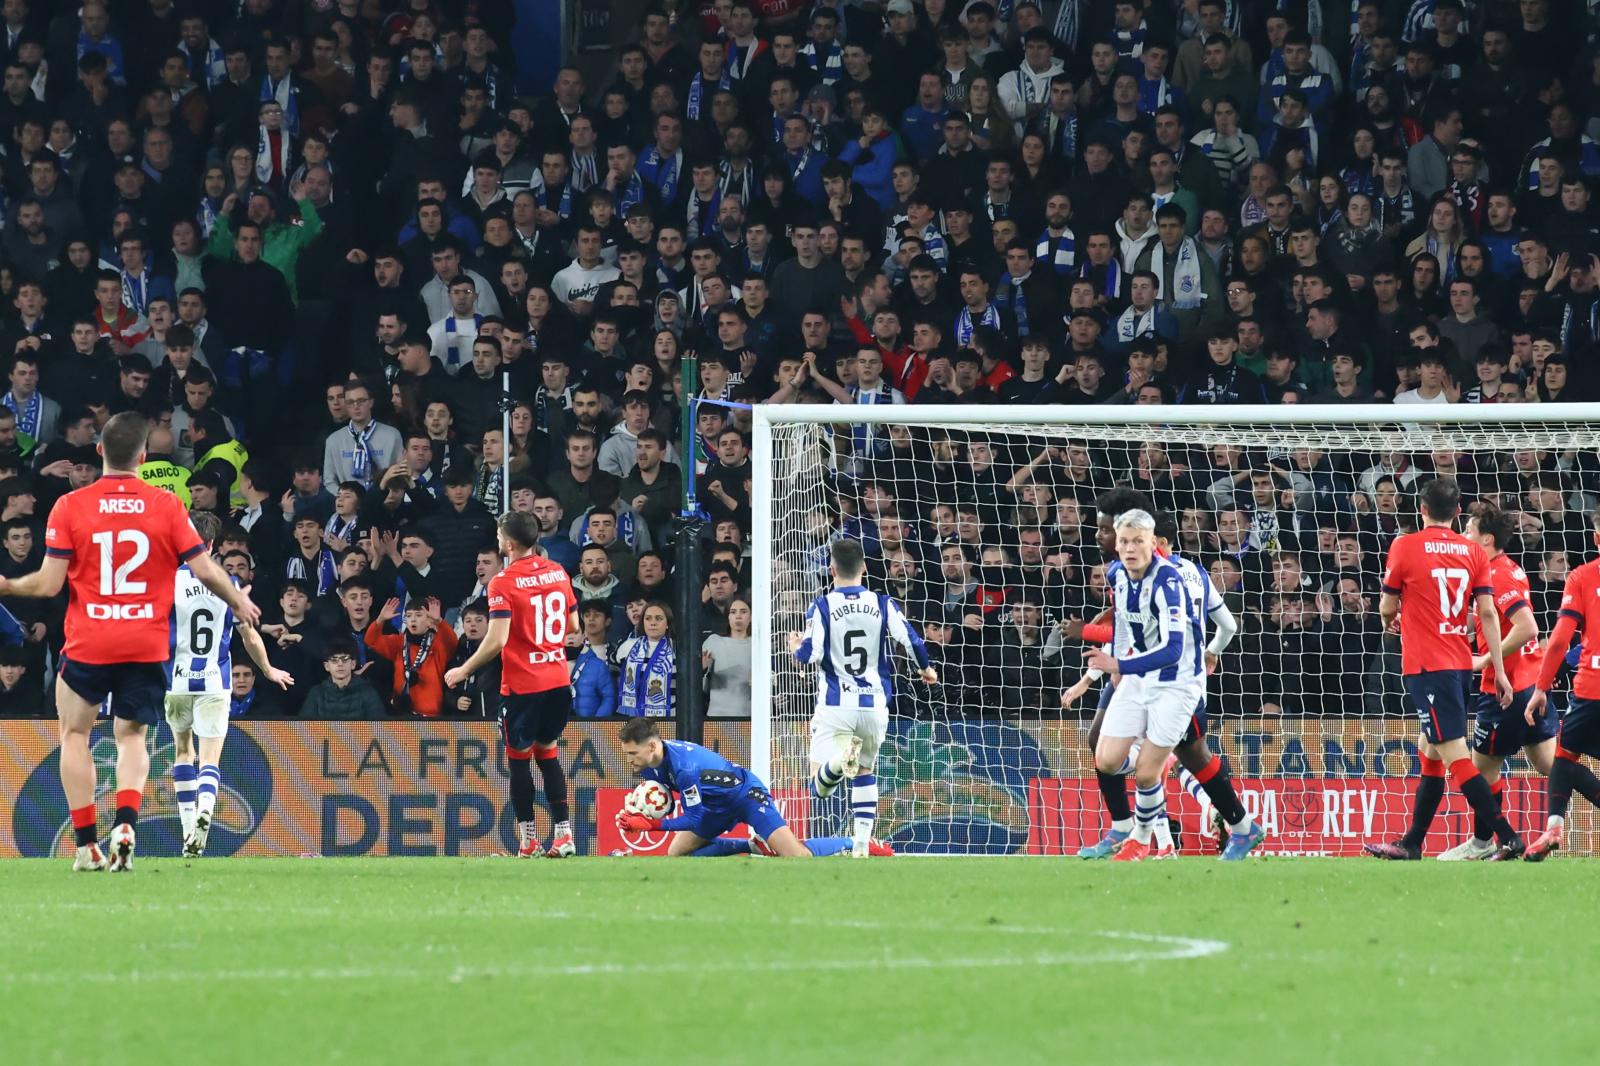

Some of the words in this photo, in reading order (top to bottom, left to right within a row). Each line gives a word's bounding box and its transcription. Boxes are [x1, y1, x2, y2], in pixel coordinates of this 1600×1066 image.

[142, 465, 180, 480] SABICO
[99, 499, 145, 514] ARESO
[92, 529, 150, 596] 12
[1424, 541, 1469, 556] BUDIMIR
[515, 575, 540, 589] IKER
[1431, 568, 1470, 618] 17
[86, 603, 154, 619] DIGI
[530, 591, 566, 645] 18
[831, 604, 880, 621] ZUBELDIA
[190, 609, 213, 656] 6
[844, 630, 867, 677] 5
[322, 739, 393, 778] LA
[419, 739, 605, 778] FRA
[1200, 790, 1279, 838] PA
[1323, 790, 1378, 838] REY
